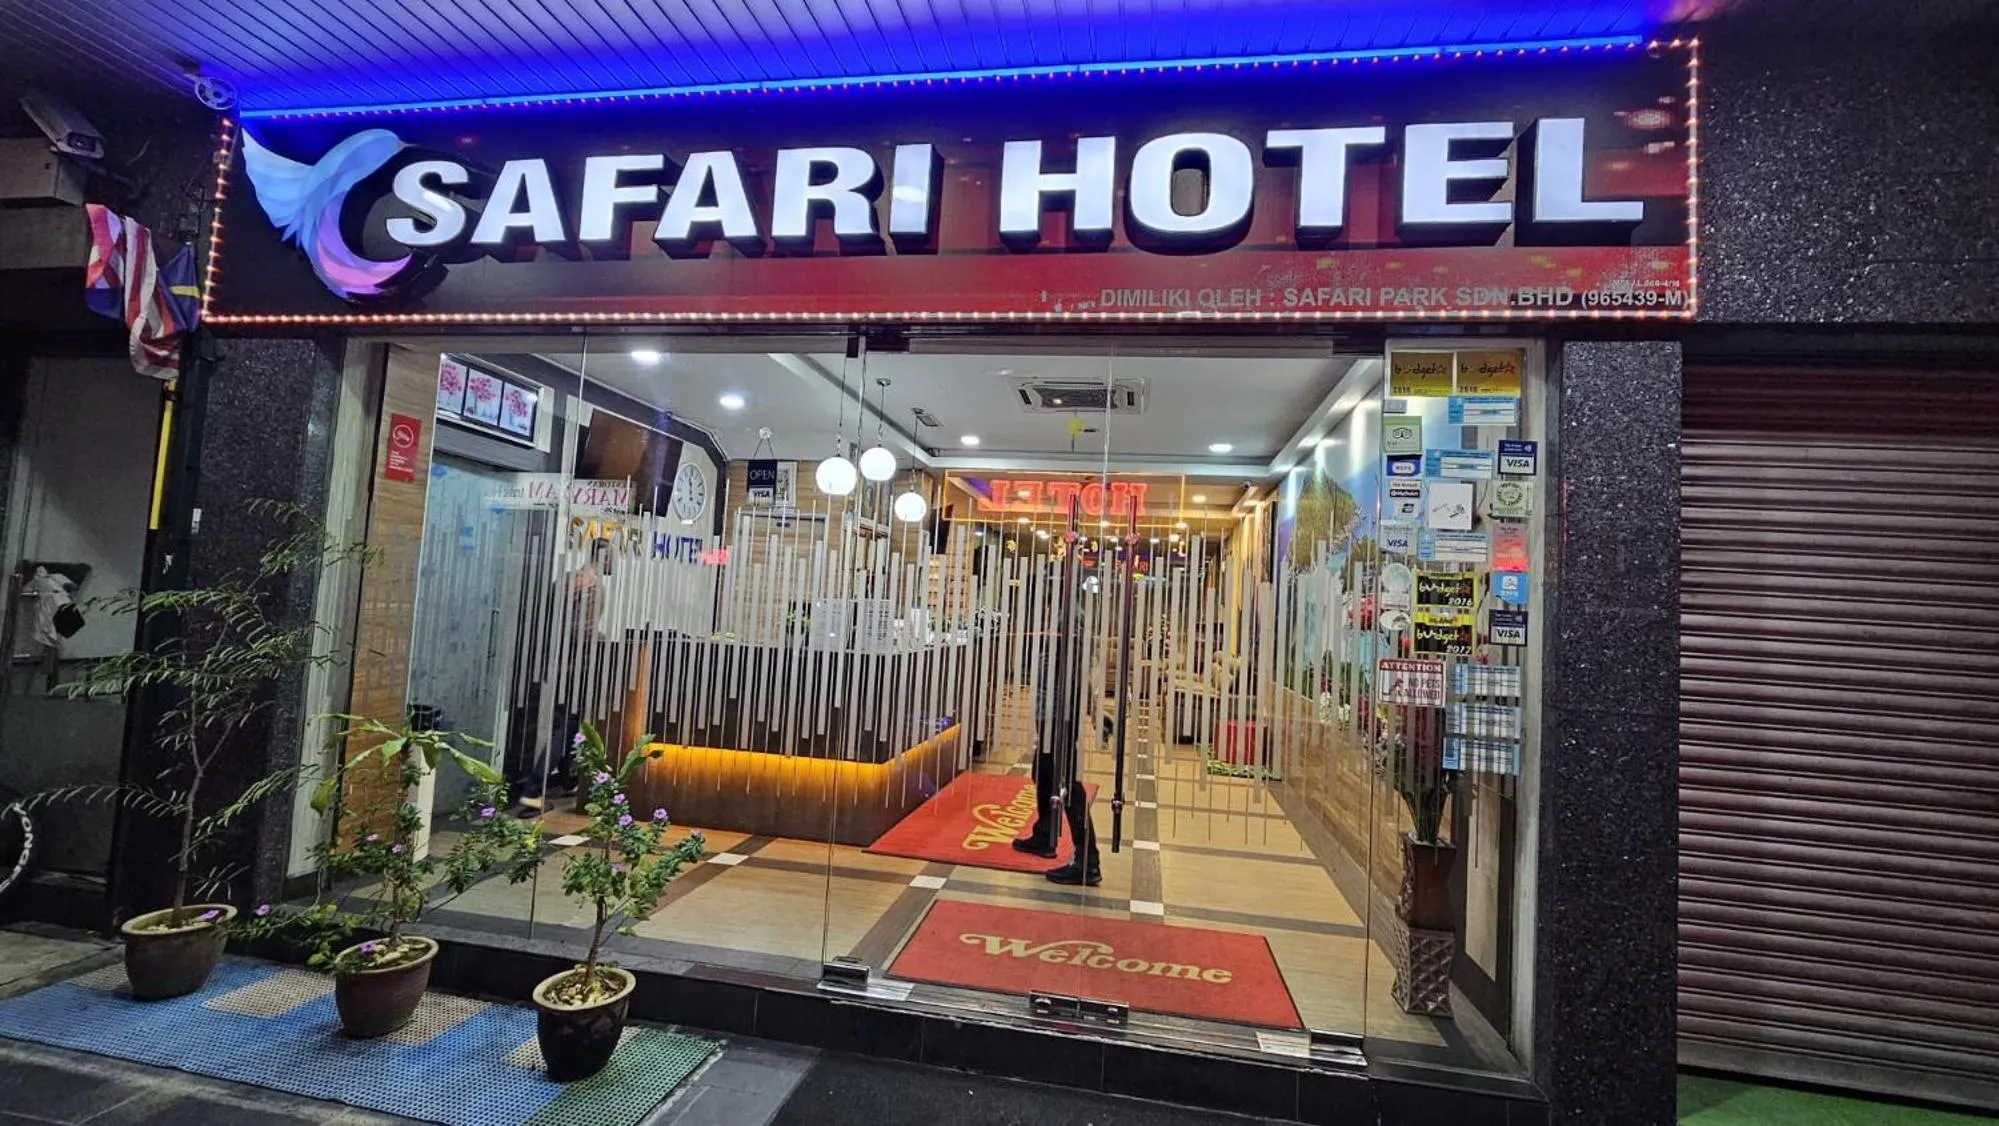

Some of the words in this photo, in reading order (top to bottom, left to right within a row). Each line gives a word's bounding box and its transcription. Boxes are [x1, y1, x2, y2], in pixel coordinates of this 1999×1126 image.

[386, 144, 933, 246] SAFARI
[1000, 117, 1644, 232] HOTEL
[1100, 288, 1190, 307] DIMILIKI
[1283, 287, 1371, 307] SAFARI
[1380, 286, 1448, 306] PARK
[1581, 288, 1690, 310] (965439-M)
[1506, 459, 1530, 467] VISA
[749, 470, 775, 480] OPEN
[1386, 538, 1408, 547] VISA
[1448, 597, 1473, 607] 2016
[1496, 628, 1520, 638] VISA
[1446, 644, 1472, 653] 2017
[1381, 661, 1441, 672] ATTENTION
[1421, 679, 1440, 689] PETS
[959, 932, 1234, 984] Welcome
